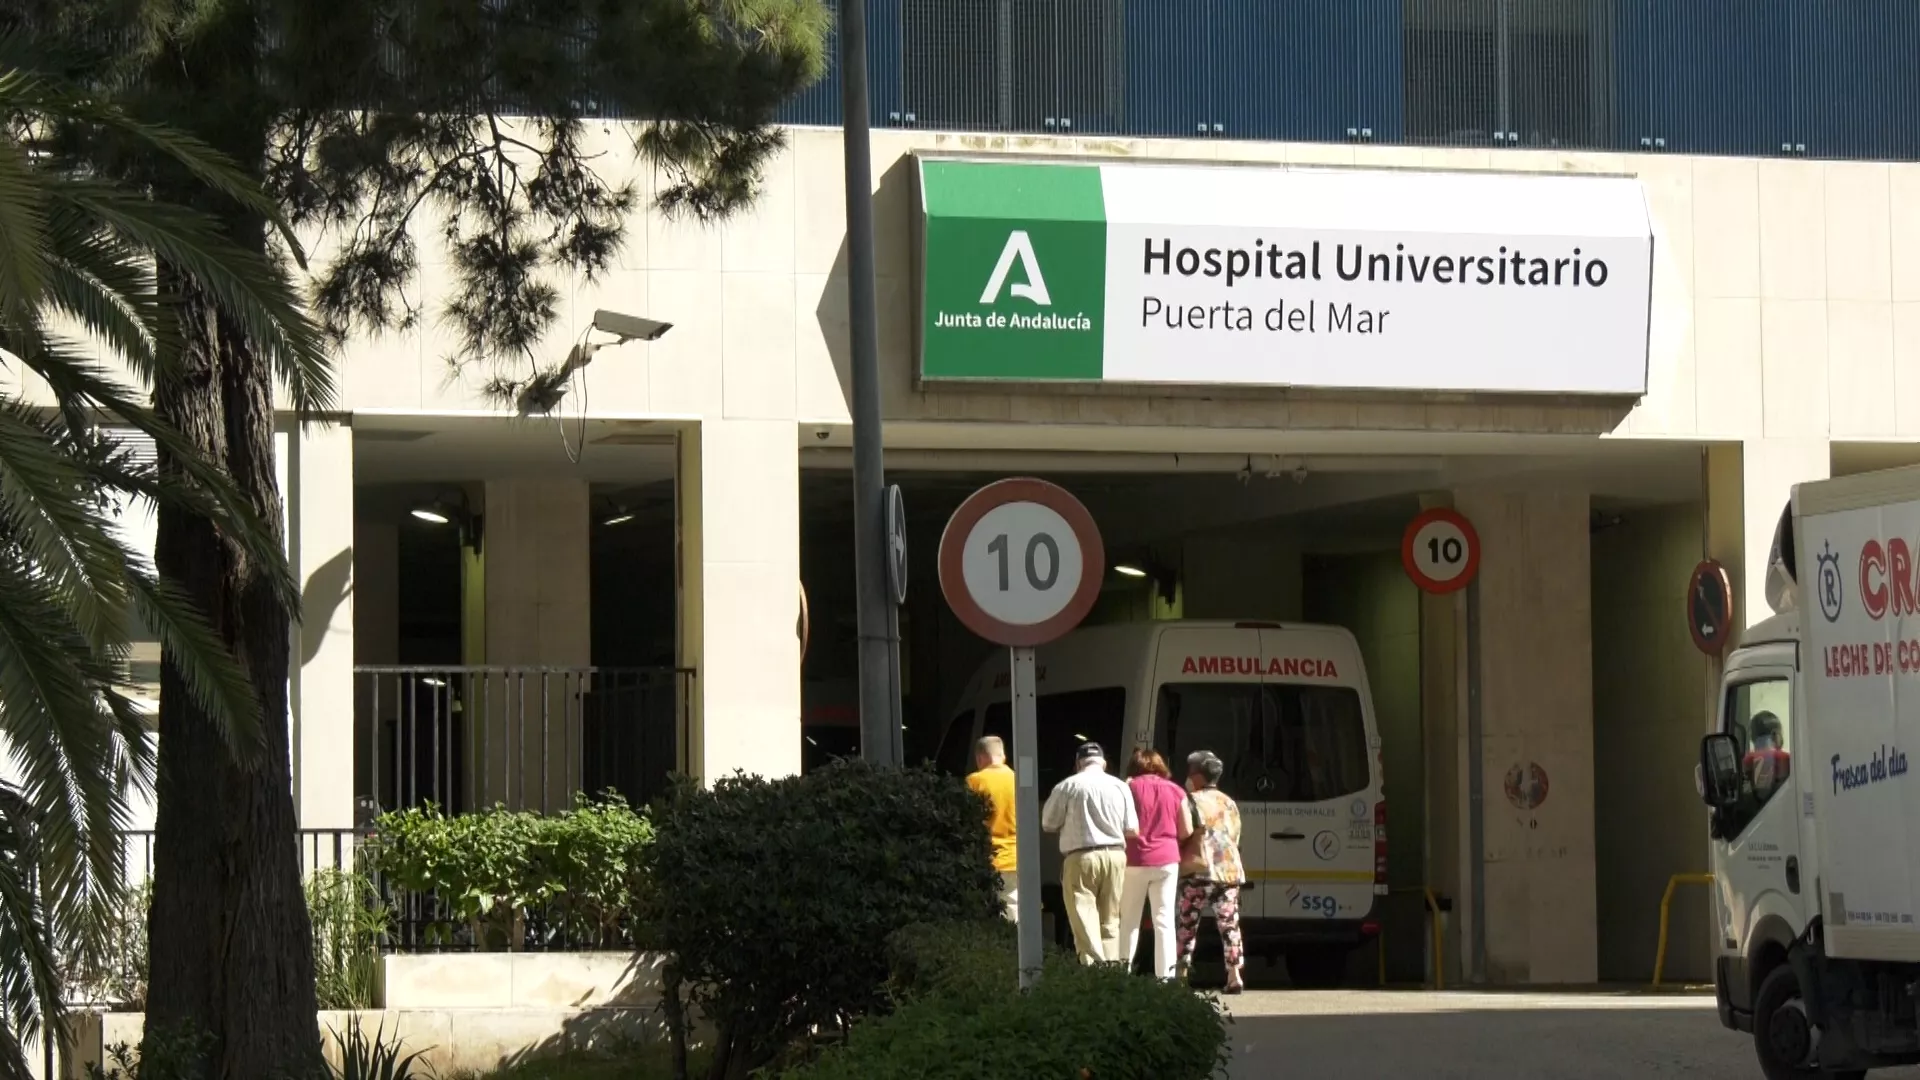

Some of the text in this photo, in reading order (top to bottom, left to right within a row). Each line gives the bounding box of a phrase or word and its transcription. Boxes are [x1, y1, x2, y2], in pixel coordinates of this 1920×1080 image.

[1143, 237, 1609, 289] Hospital Universitario
[934, 310, 1092, 331] Junta de Andalucía
[1142, 296, 1391, 335] Puerta del Mar
[987, 532, 1059, 593] 10
[1427, 535, 1463, 565] 10
[1858, 537, 1920, 621] CR
[1182, 656, 1338, 679] AMBULANCIA
[1824, 643, 1870, 679] LECHE
[1873, 641, 1894, 676] DE
[1831, 753, 1869, 798] Fresca
[1870, 744, 1888, 784] del
[1301, 895, 1338, 918] ssg
